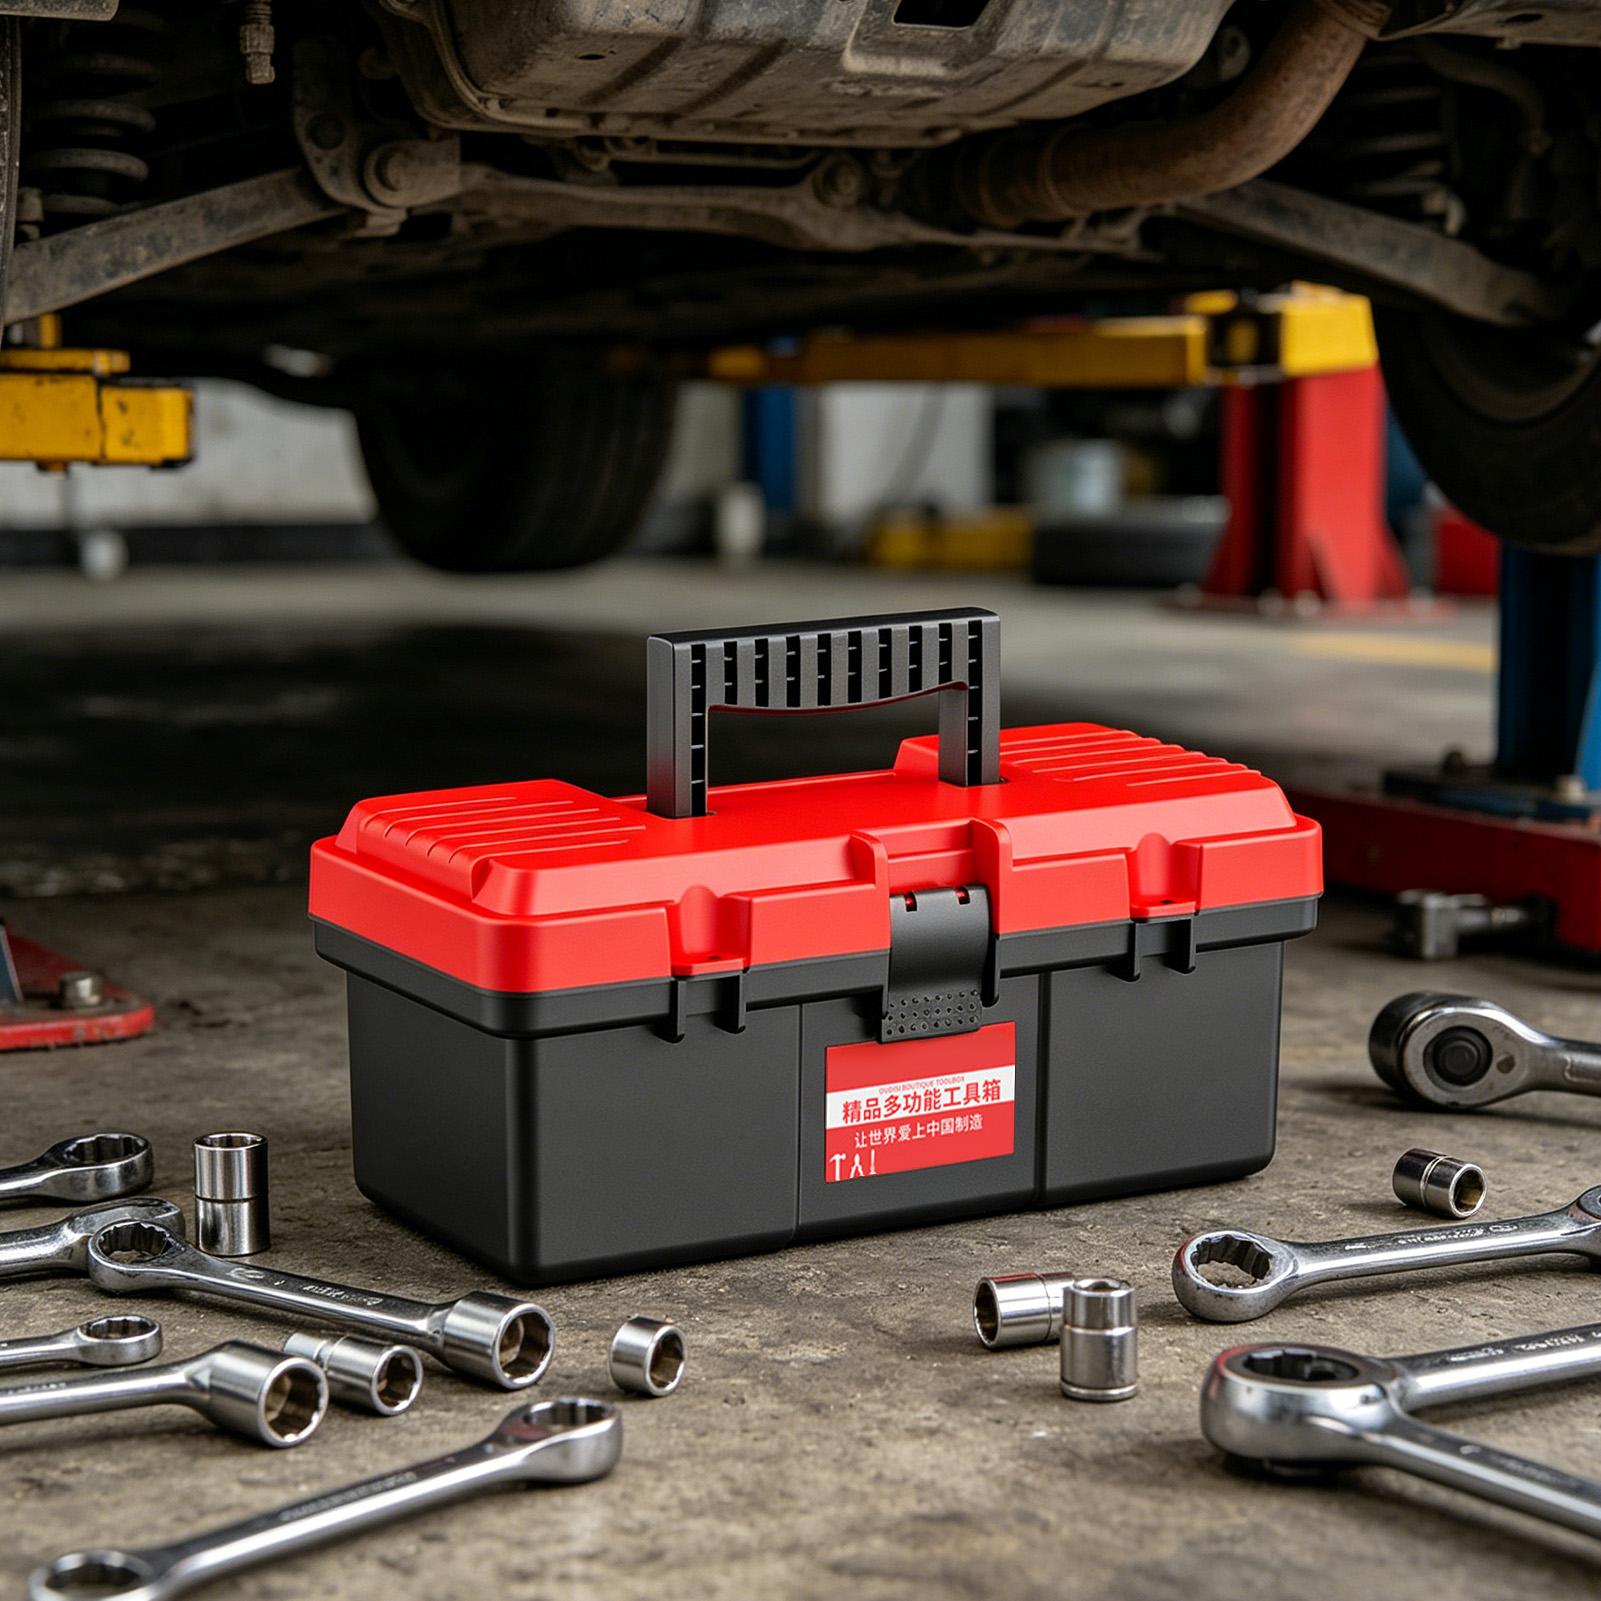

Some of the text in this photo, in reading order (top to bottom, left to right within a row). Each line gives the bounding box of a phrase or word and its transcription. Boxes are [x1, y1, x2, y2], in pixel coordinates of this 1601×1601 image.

[842, 1079, 1002, 1124] 精品多功能工具箱
[902, 1080, 934, 1092] BOUTIQUE
[936, 1076, 965, 1087] TOOLBOX
[854, 1114, 983, 1149] 让世界爱上中国制造
